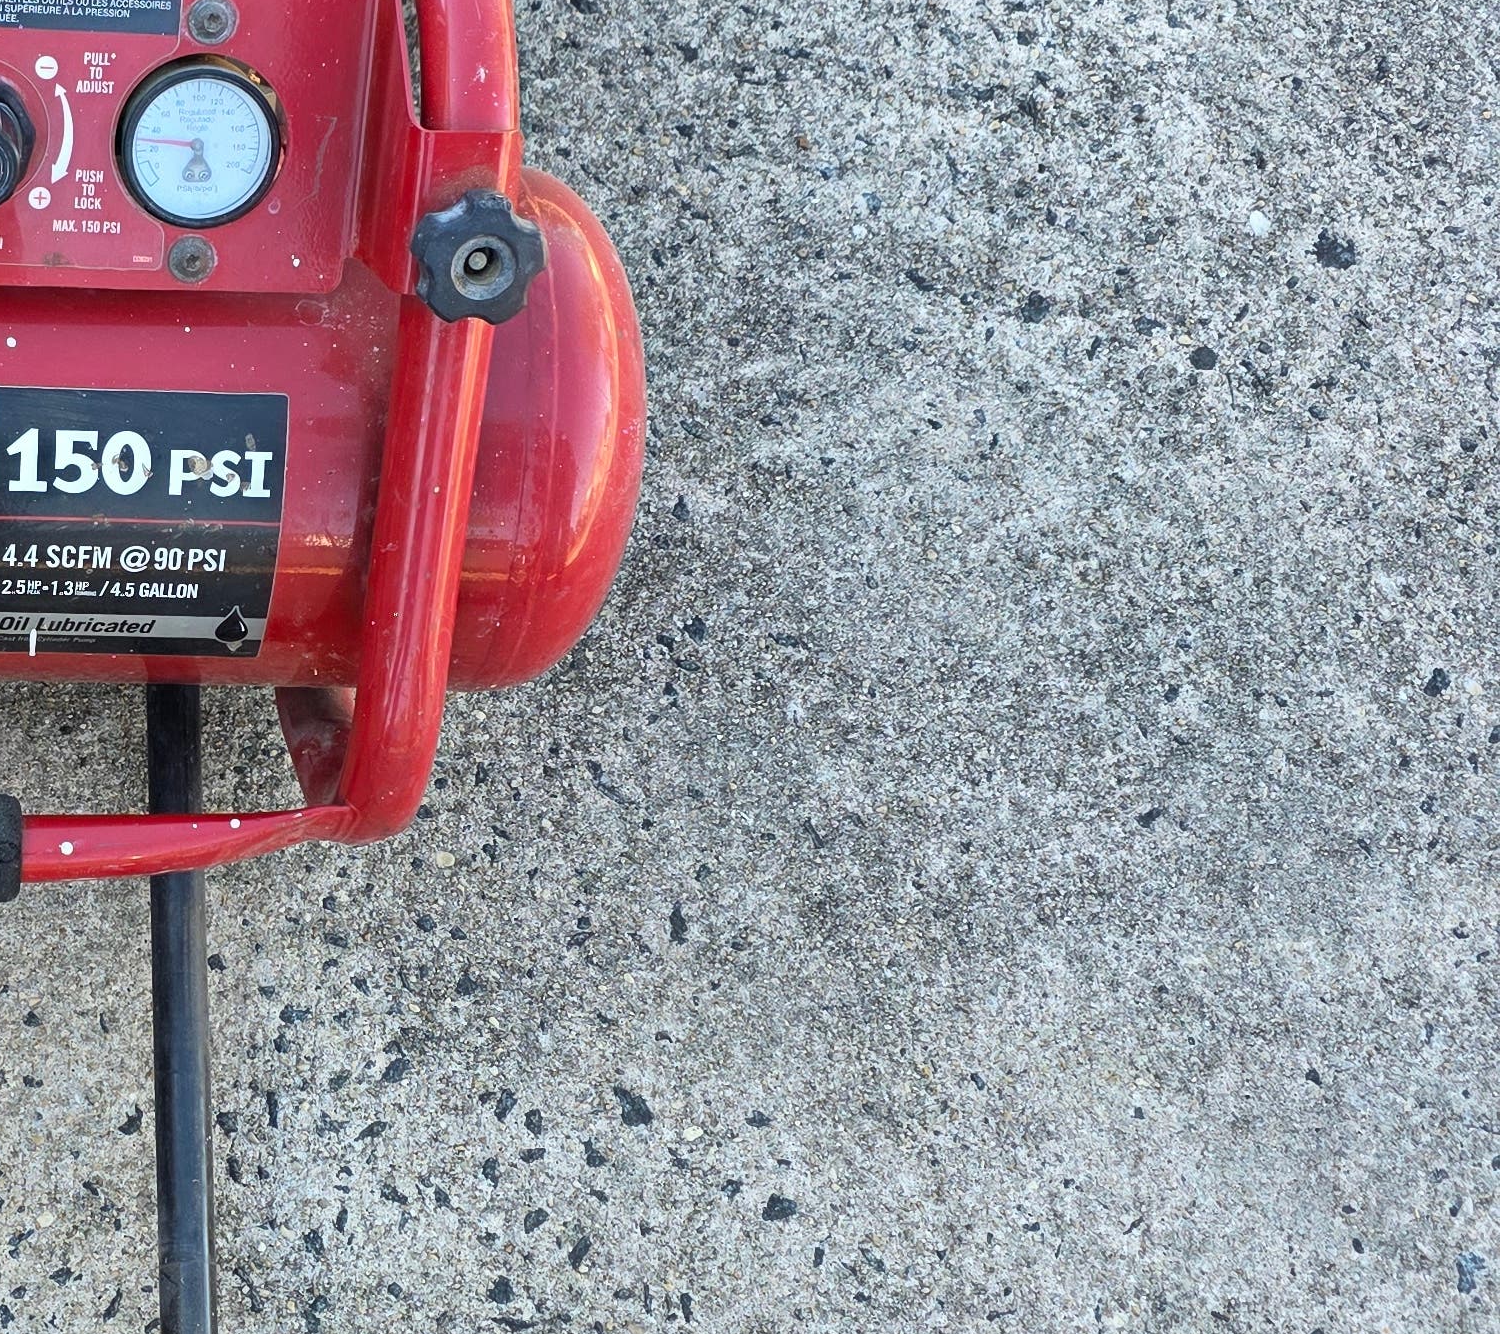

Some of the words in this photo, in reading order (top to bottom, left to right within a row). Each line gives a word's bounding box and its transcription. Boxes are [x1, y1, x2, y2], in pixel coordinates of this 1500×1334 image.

[91, 0, 108, 7] LES
[110, 0, 171, 10] ACCESSOIRES
[72, 7, 82, 15] LA
[85, 8, 130, 18] PRESSION
[90, 66, 102, 80] TO
[76, 80, 114, 94] ADJUST
[76, 170, 104, 184] PUSH
[82, 184, 95, 196] TO
[74, 197, 102, 210] LOCK
[52, 220, 78, 232] MAX.
[82, 221, 100, 234] 150
[103, 222, 120, 234] PSI
[6, 428, 152, 496] 150
[168, 450, 272, 498] PSI
[2, 544, 38, 568] 4.4
[46, 545, 112, 570] SCFM
[120, 546, 150, 572] @
[154, 547, 184, 570] 90
[188, 548, 226, 572] PSI
[139, 583, 198, 598] GALLON
[35, 618, 156, 634] Lubricated
